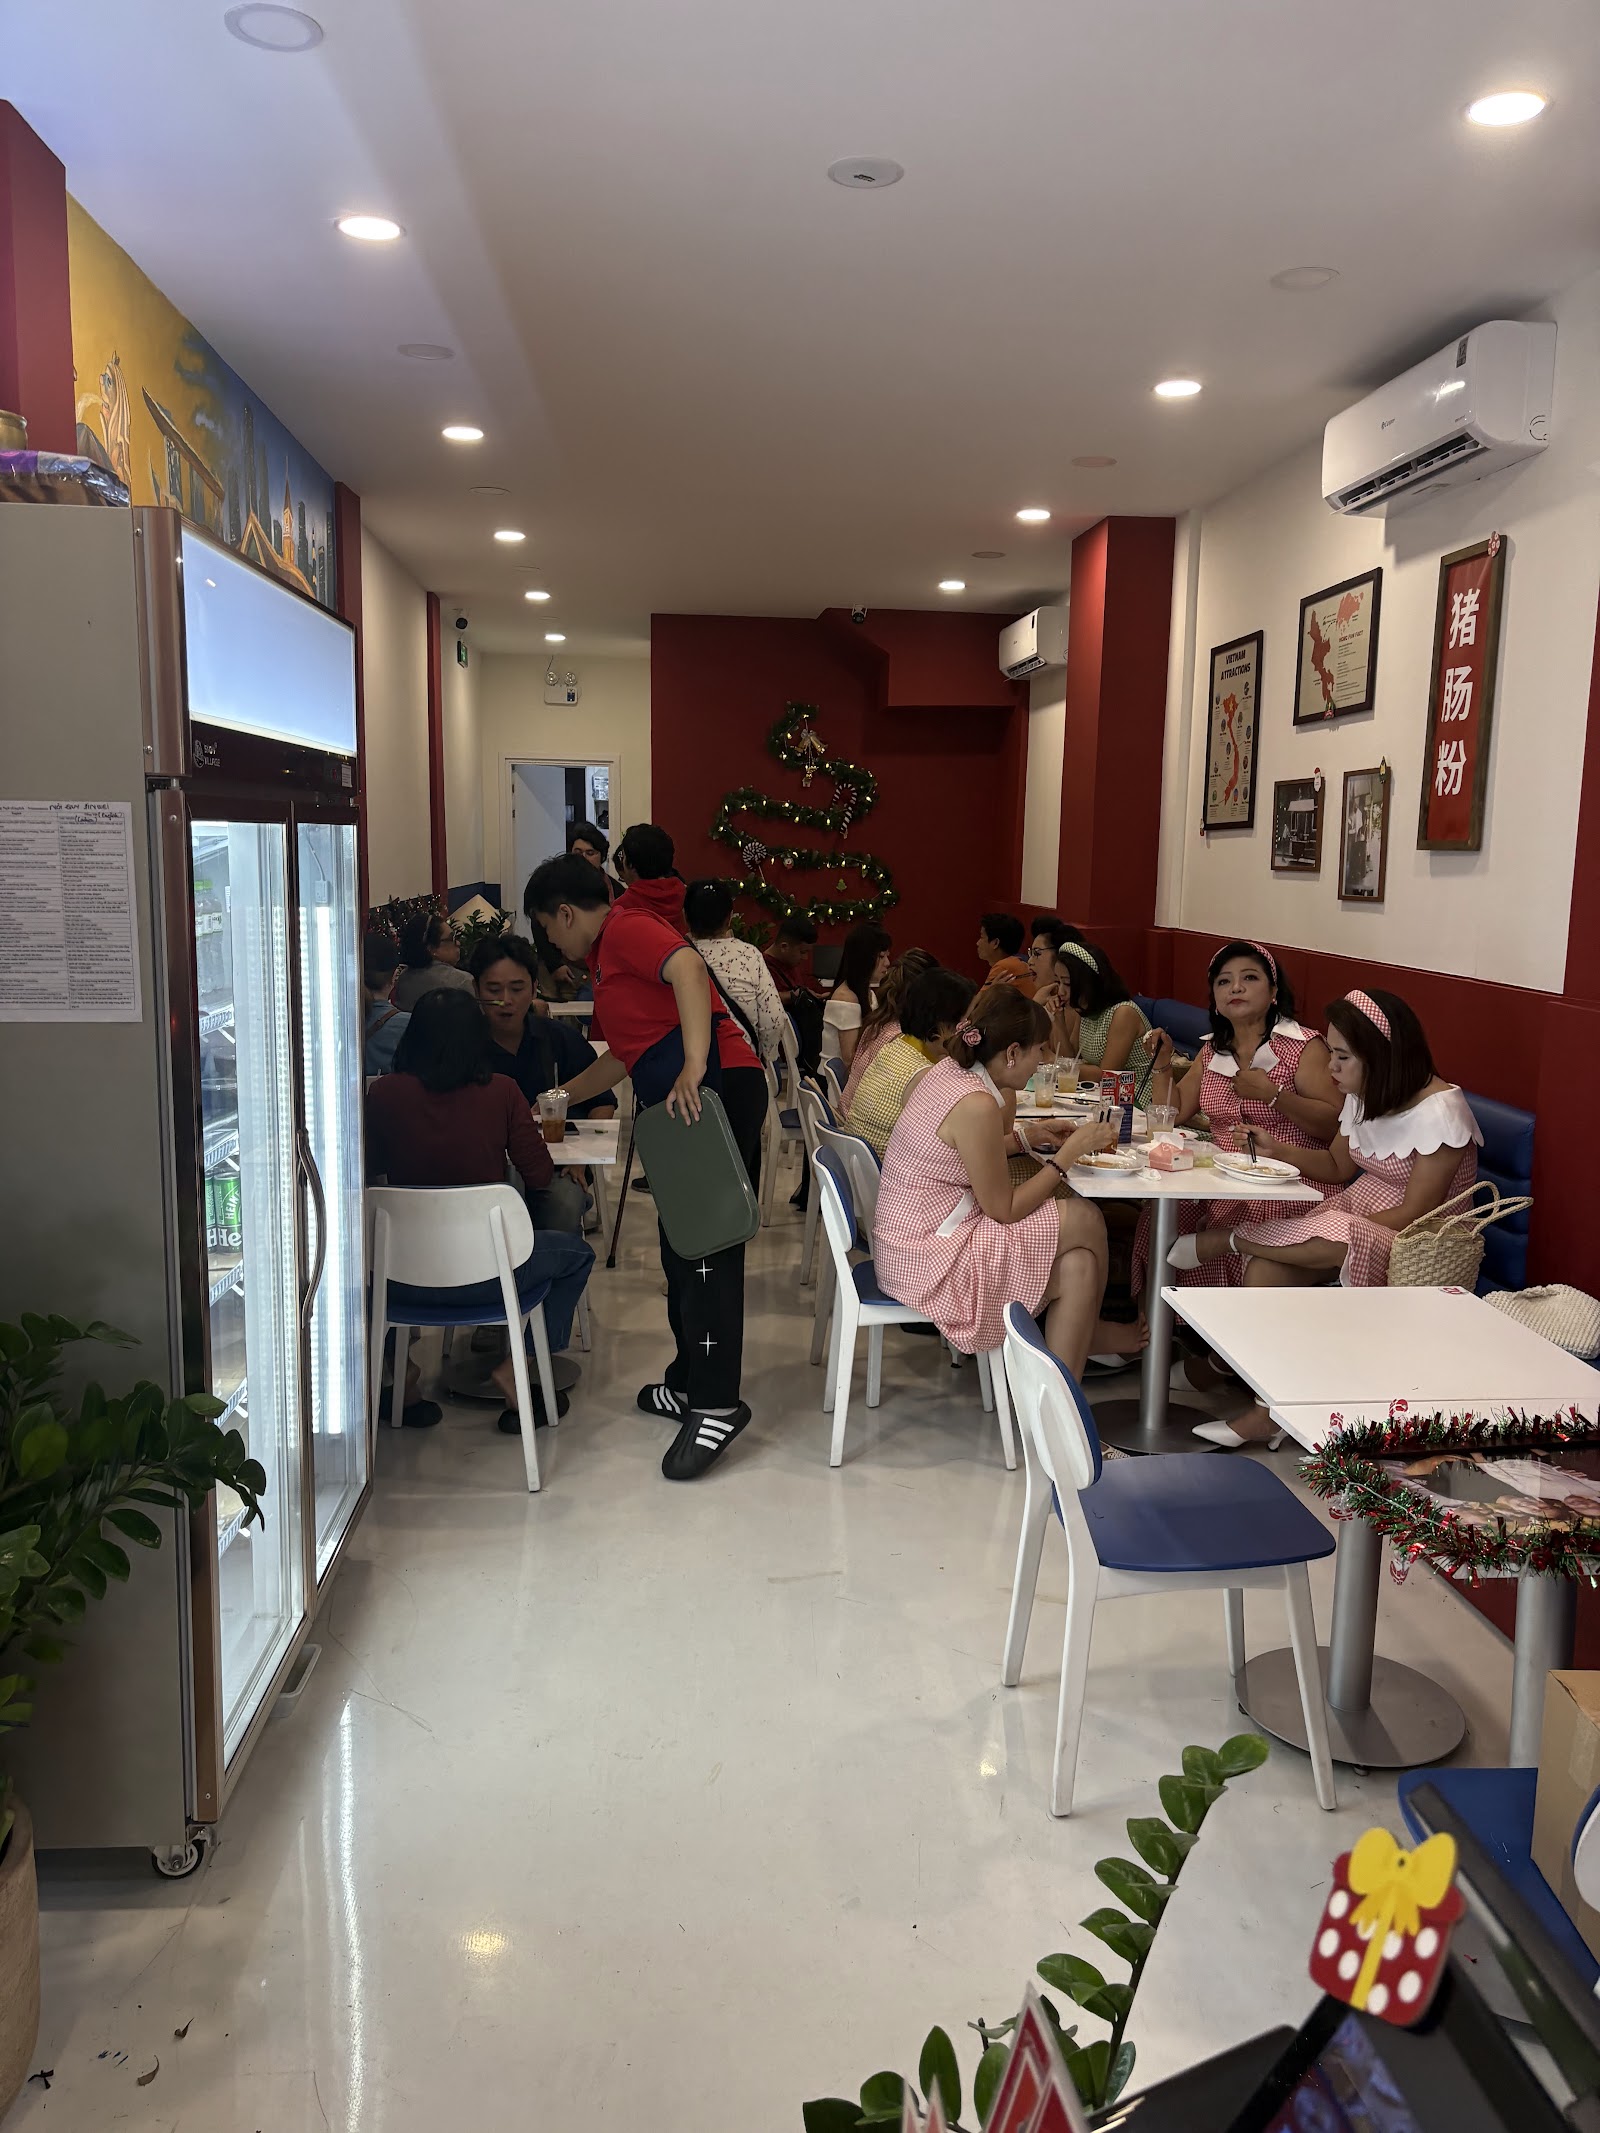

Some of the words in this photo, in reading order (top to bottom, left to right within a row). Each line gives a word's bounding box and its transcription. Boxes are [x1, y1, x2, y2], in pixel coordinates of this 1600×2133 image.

[1225, 649, 1246, 665] VIETNAM
[1220, 662, 1251, 681] ATTRACTIONS
[1435, 588, 1481, 797] 猪肠粉
